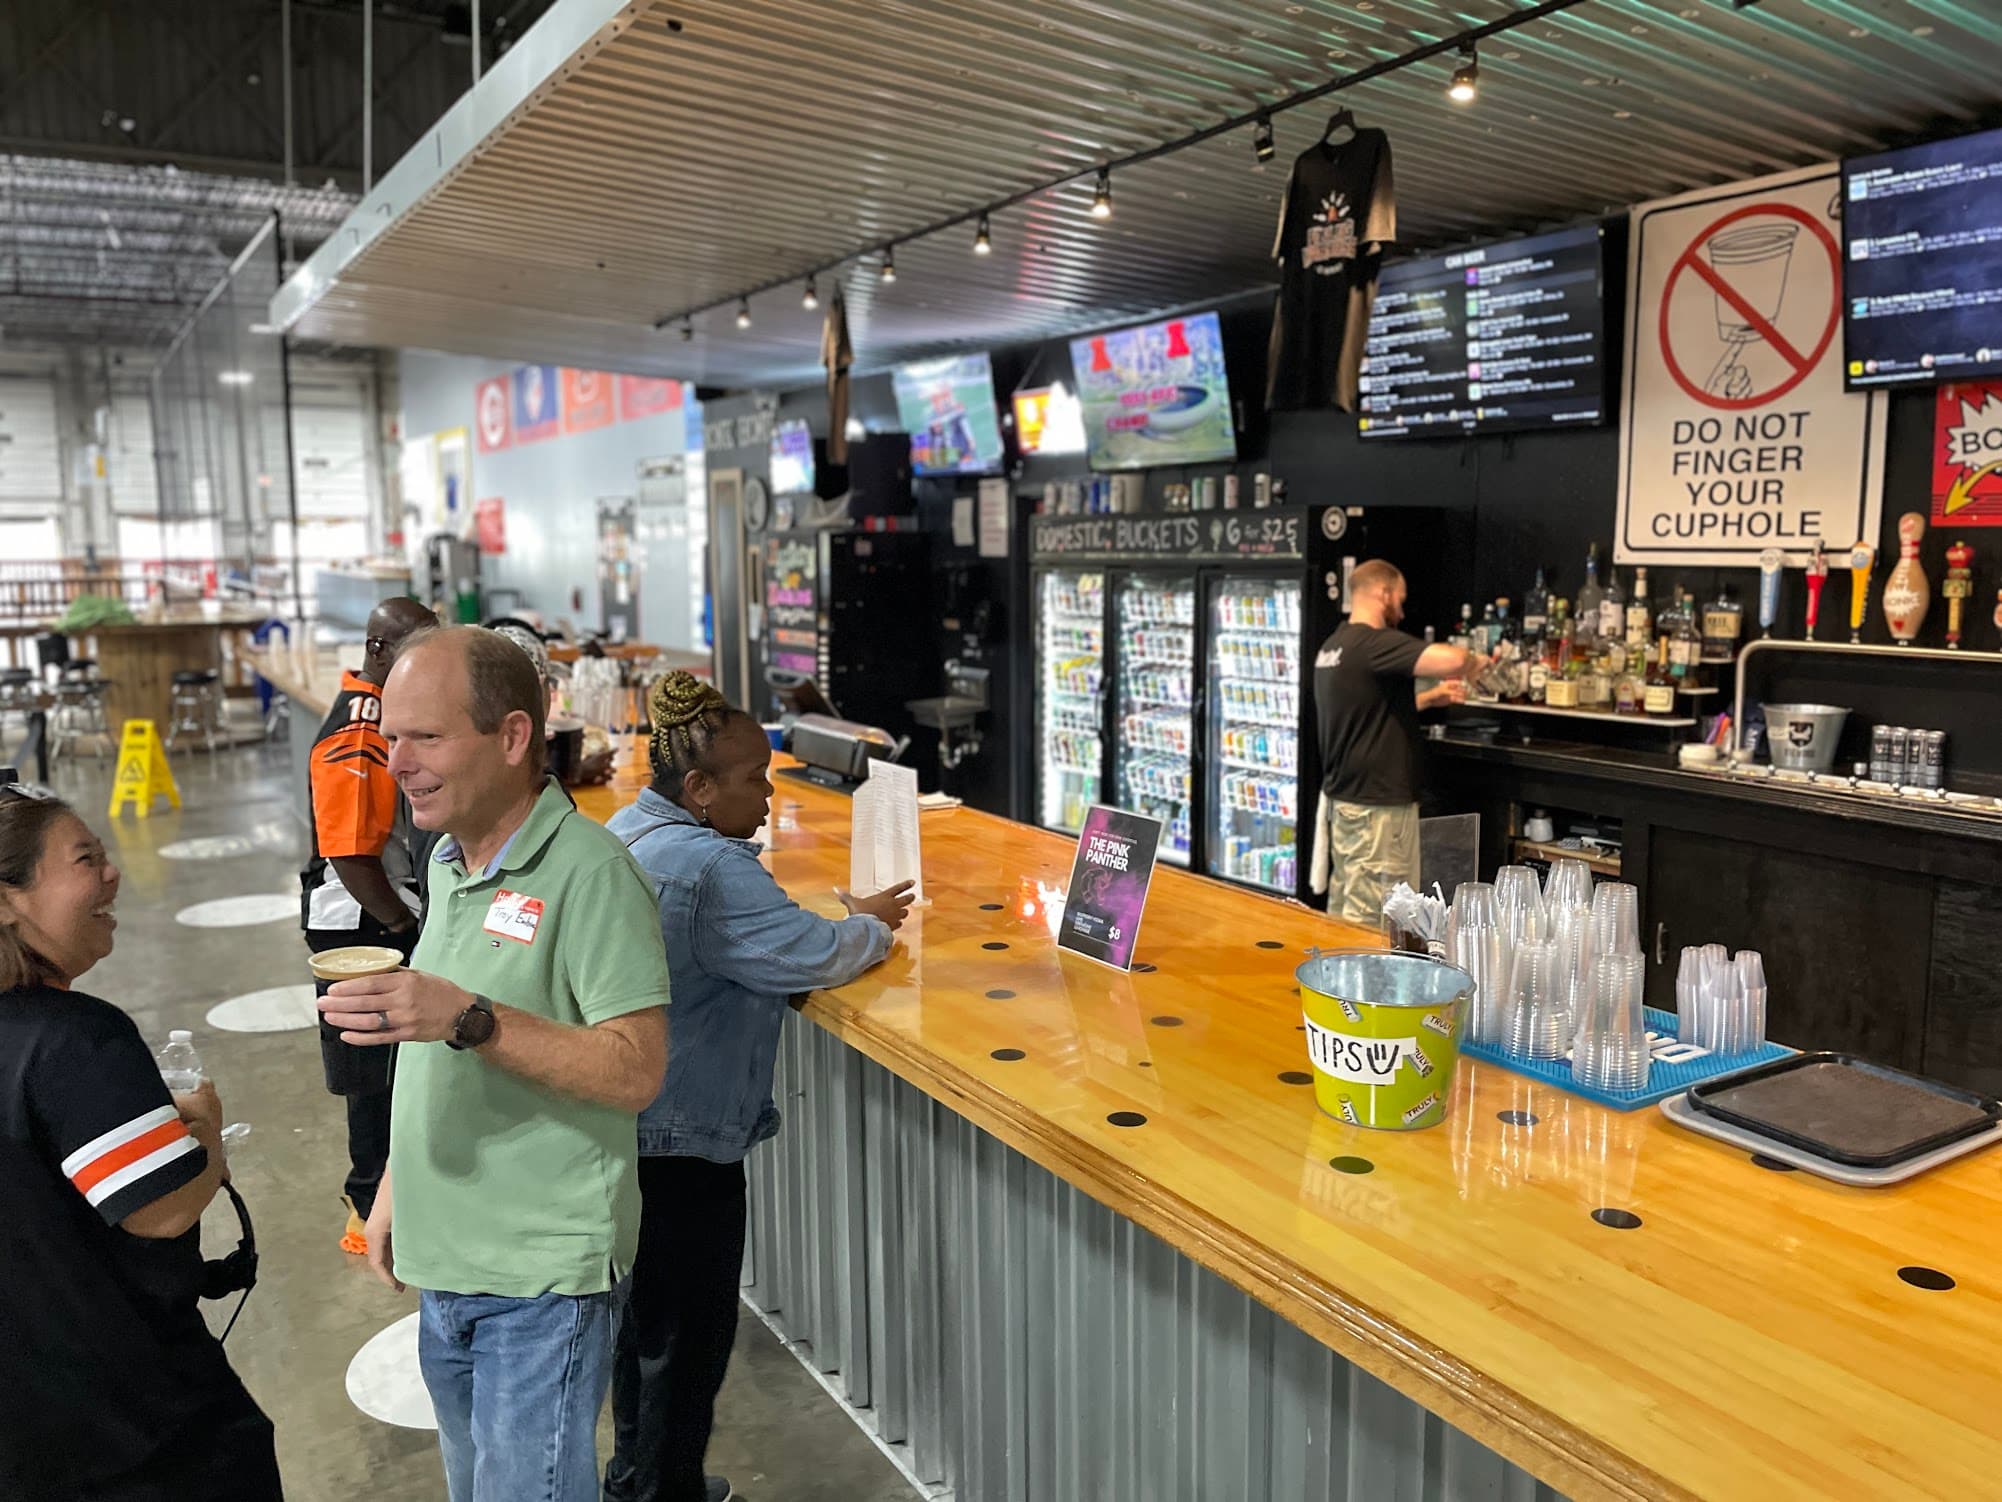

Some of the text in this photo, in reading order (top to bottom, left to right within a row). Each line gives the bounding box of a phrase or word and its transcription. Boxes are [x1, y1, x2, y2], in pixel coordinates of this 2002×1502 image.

[1673, 411, 1811, 445] DO NOT
[1673, 445, 1803, 475] FINGER
[1686, 479, 1784, 506] YOUR
[1036, 521, 1105, 550] DOMESTIC
[1115, 517, 1199, 550] BUCKETS
[1226, 518, 1240, 545] 6
[1652, 511, 1822, 537] CUPHOLE
[348, 696, 380, 721] 18
[1090, 836, 1107, 852] THE
[1106, 840, 1131, 858] PINK
[1085, 849, 1129, 872] PANTHER
[1108, 925, 1121, 940] $8
[1307, 1023, 1363, 1072] TIPS
[1405, 1095, 1433, 1117] TRULY
